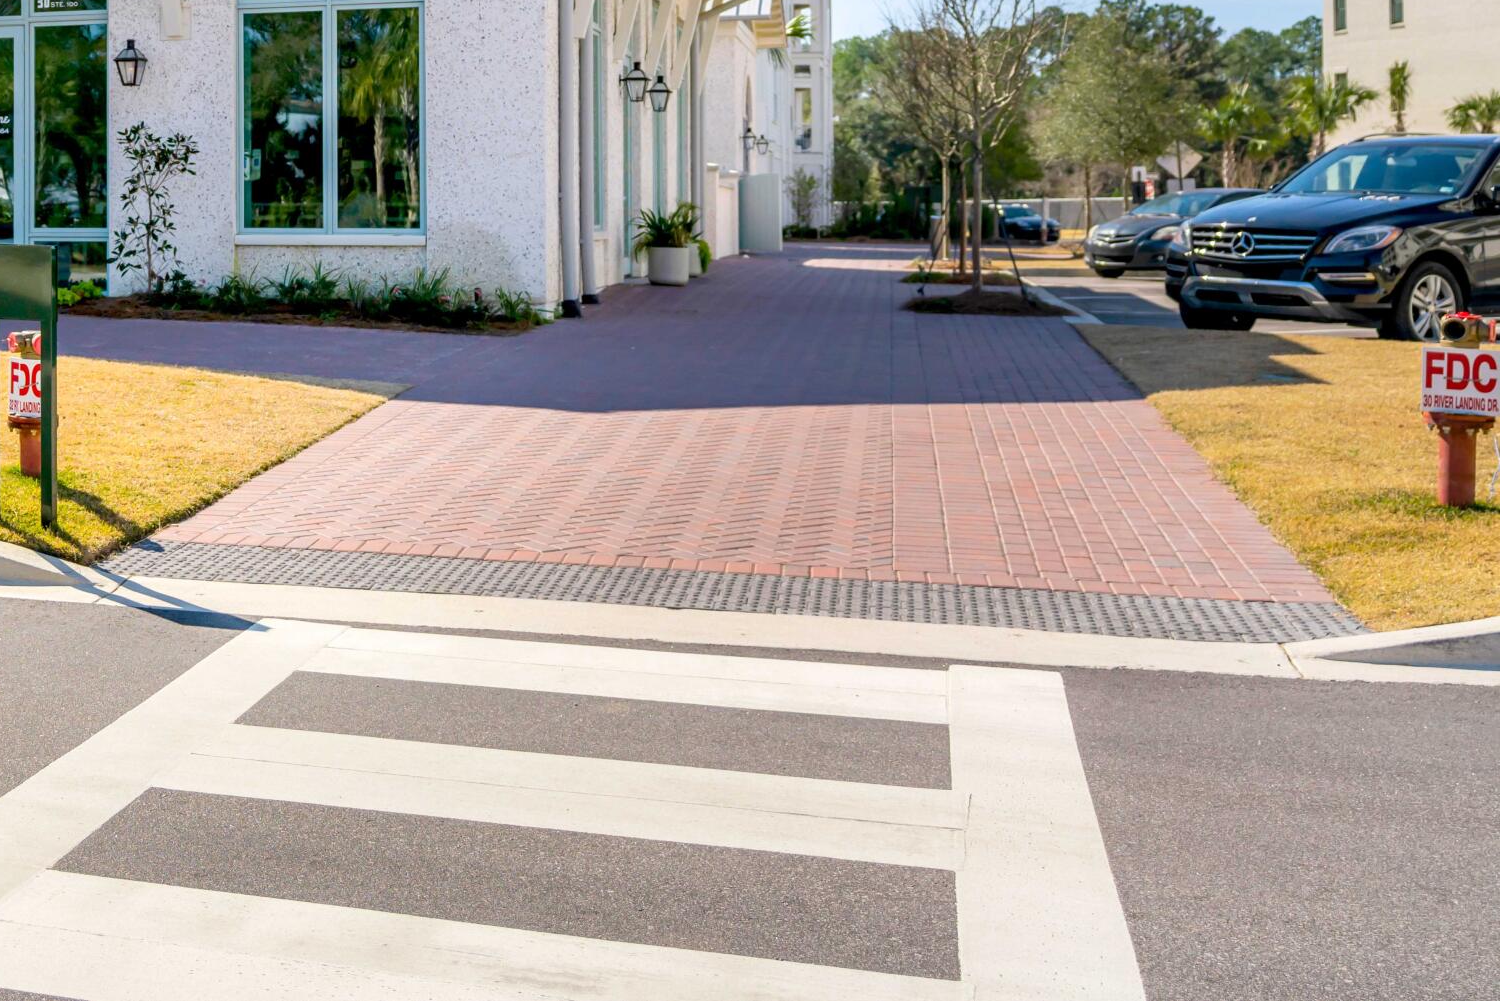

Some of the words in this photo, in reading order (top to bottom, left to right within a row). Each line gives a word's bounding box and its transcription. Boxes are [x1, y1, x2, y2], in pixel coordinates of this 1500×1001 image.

[1425, 351, 1498, 394] FDC
[1423, 394, 1433, 408] 30
[1433, 395, 1454, 409] RIVER
[1455, 396, 1486, 411] LANDING
